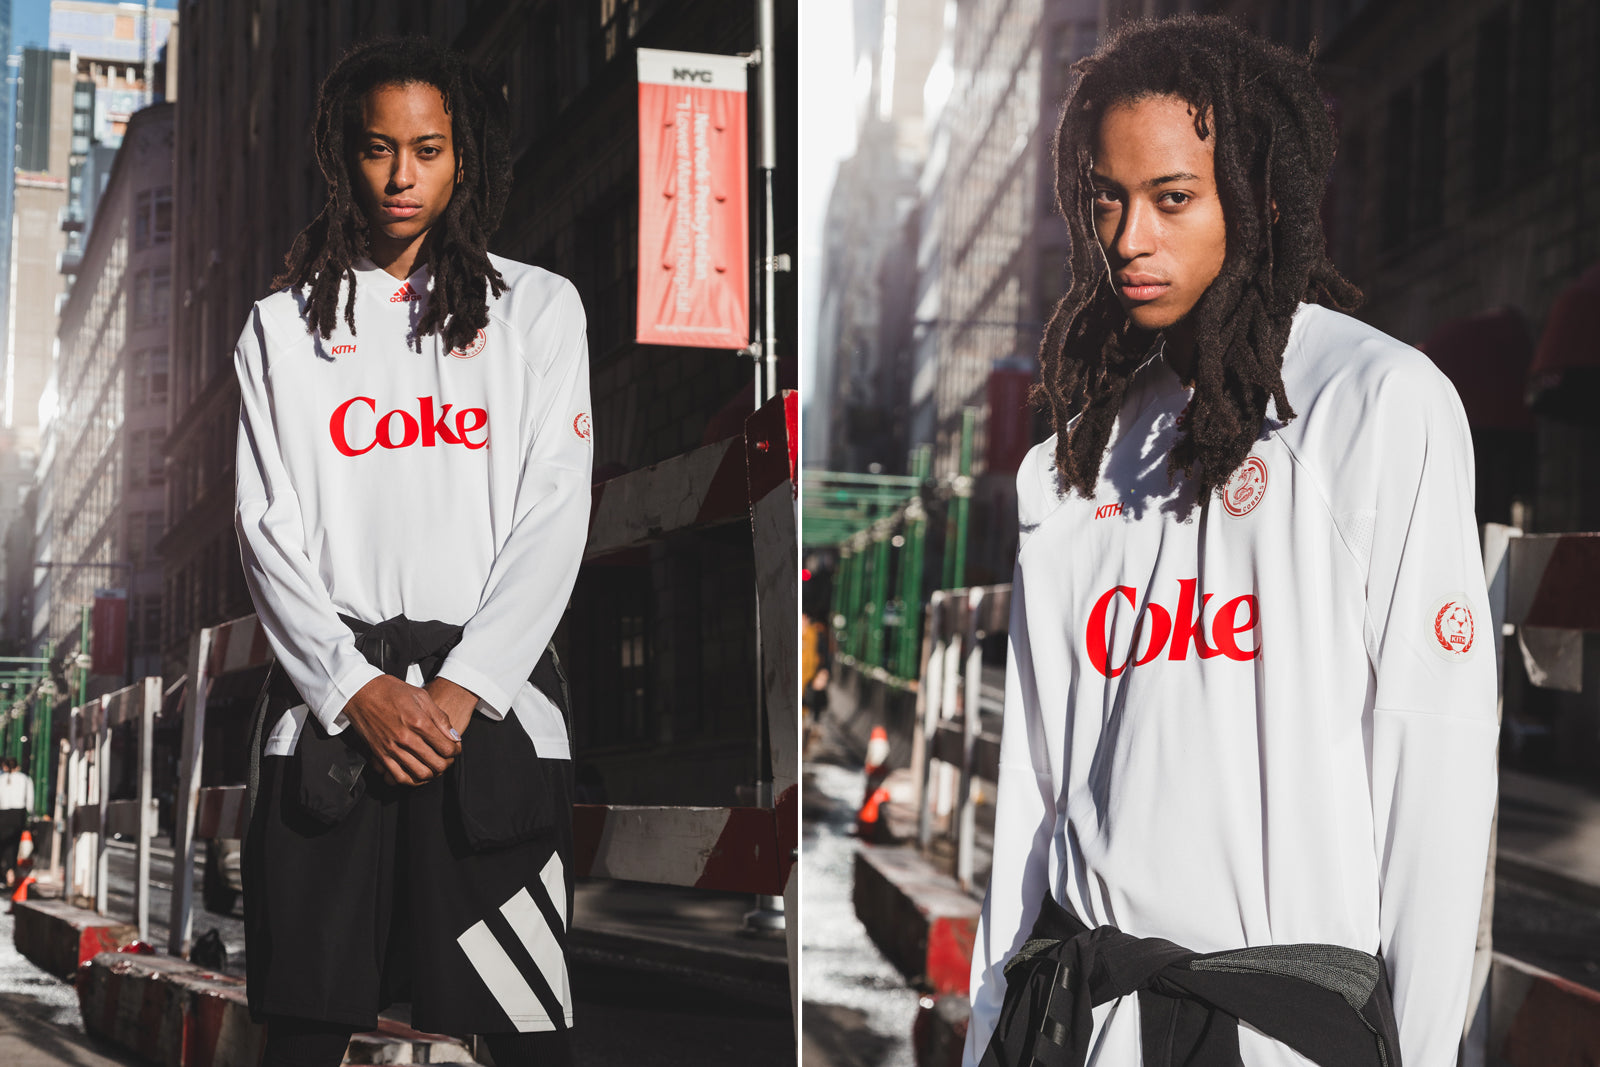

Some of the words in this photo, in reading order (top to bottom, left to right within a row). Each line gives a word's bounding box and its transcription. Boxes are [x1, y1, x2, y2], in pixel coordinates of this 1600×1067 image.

[673, 67, 713, 83] NYC
[675, 111, 691, 157] Lower
[676, 158, 692, 245] Manhattan
[389, 293, 422, 303] adidas
[673, 247, 692, 312] Hospital
[331, 344, 357, 355] KITH
[329, 395, 489, 458] Coke
[1094, 501, 1125, 520] KITH
[1242, 485, 1265, 513] COBRAS
[1085, 577, 1262, 680] Coke
